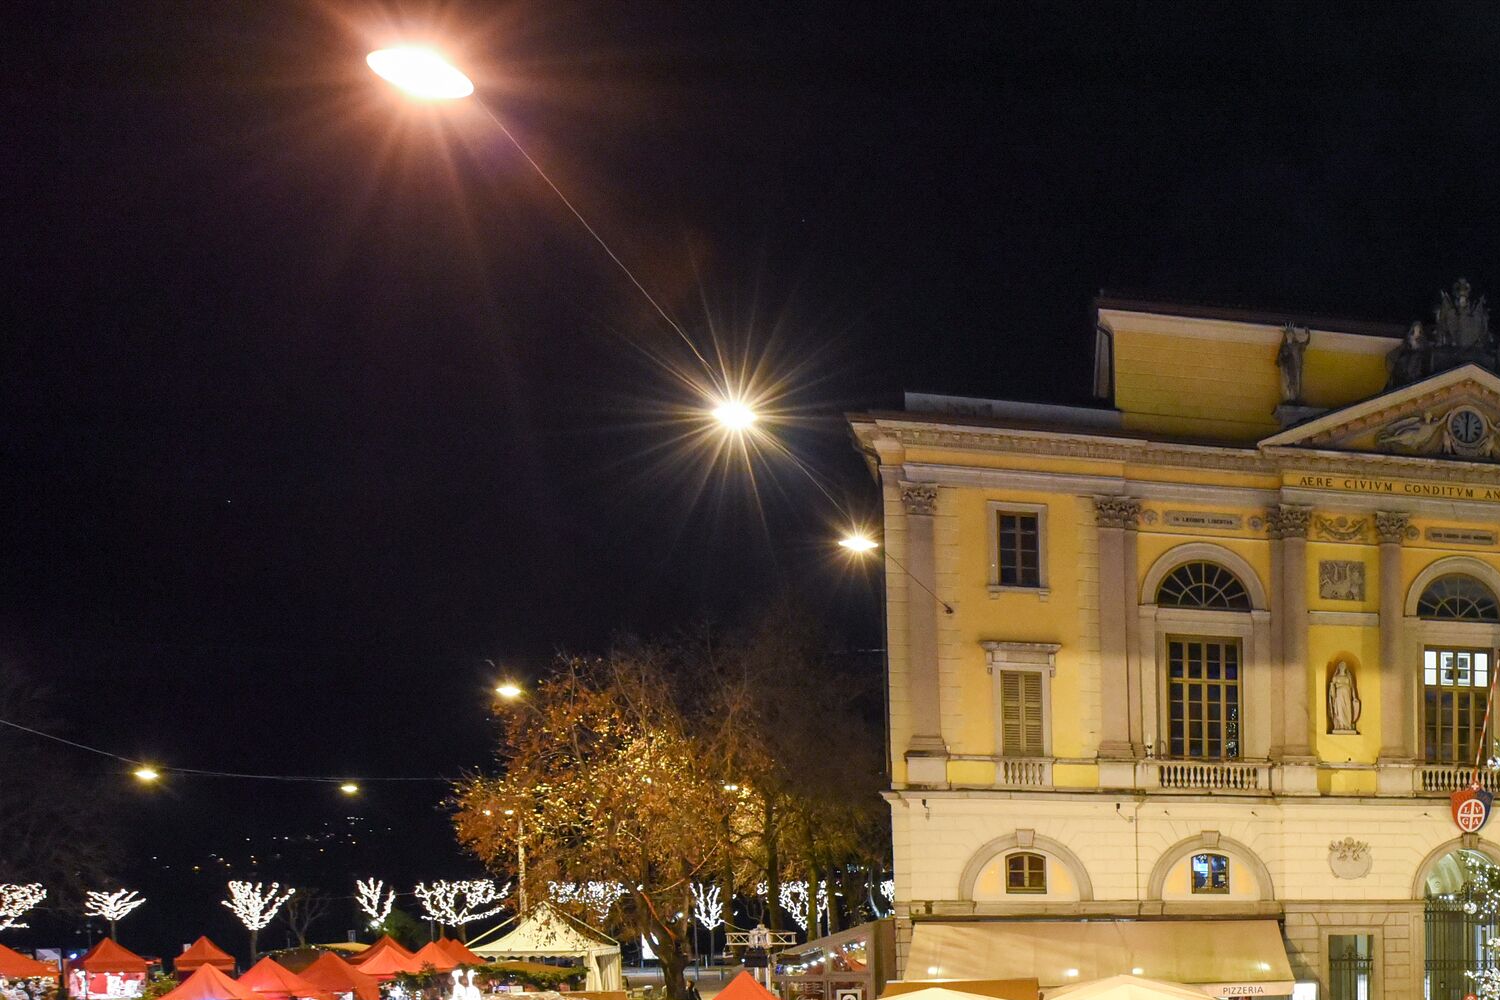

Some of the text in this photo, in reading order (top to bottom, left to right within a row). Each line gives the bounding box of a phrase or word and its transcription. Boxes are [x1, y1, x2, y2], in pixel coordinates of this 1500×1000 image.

[1300, 476, 1333, 487] AERE
[1344, 479, 1393, 492] CIVIVM
[1404, 483, 1474, 498] CONDITVM
[1222, 986, 1264, 995] PIZZERIA
